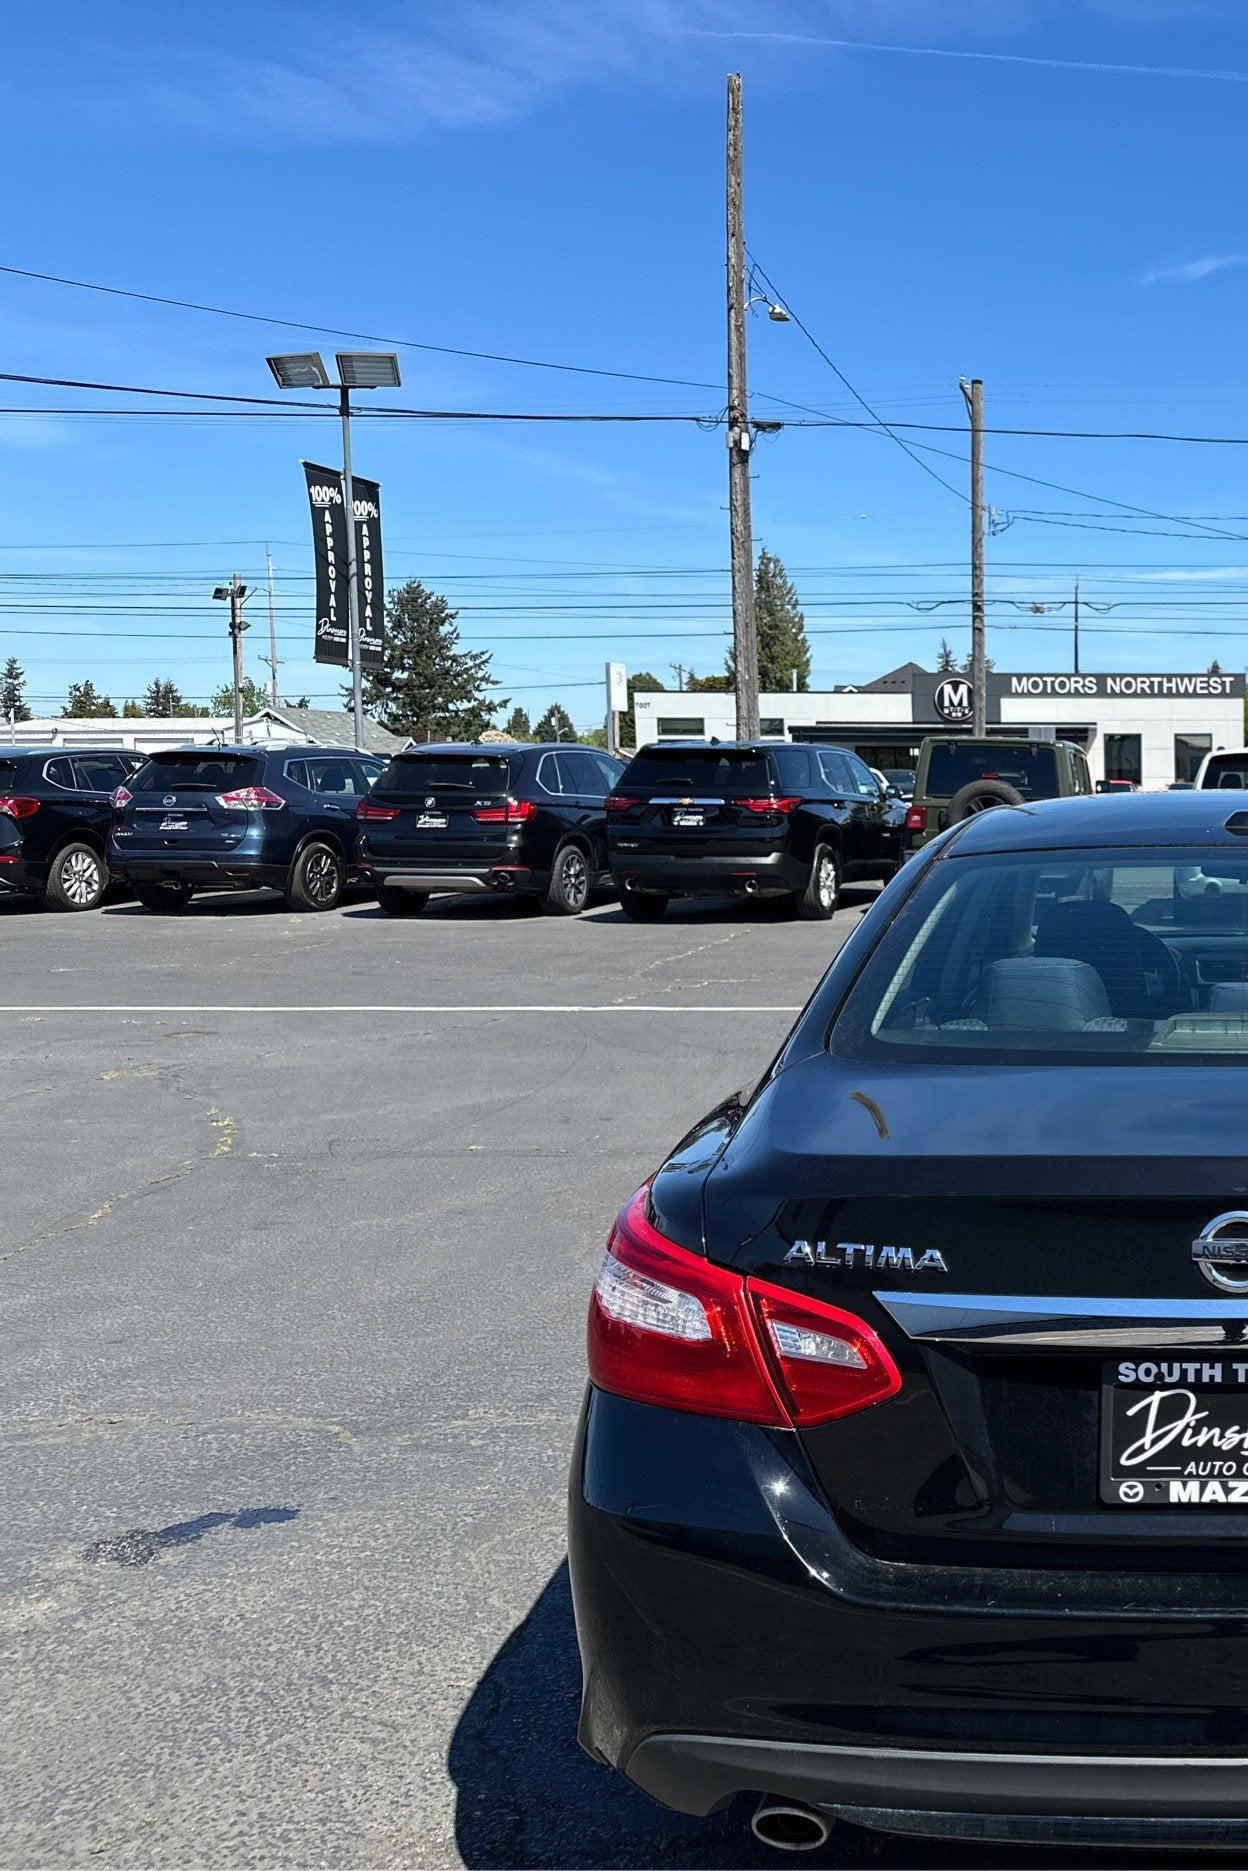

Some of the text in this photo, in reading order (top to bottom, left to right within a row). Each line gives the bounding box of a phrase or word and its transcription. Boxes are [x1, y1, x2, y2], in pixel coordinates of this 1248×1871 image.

[310, 485, 342, 504] 100%
[352, 500, 379, 518] 00%
[324, 509, 337, 621] APPROVAL
[361, 523, 373, 631] APPROVAL
[943, 684, 969, 707] M
[1011, 676, 1235, 695] MOTORS NORTHWEST
[782, 1239, 949, 1273] ALTIMA
[1118, 1361, 1223, 1384] SOUTH
[1184, 1461, 1237, 1476] AUTO
